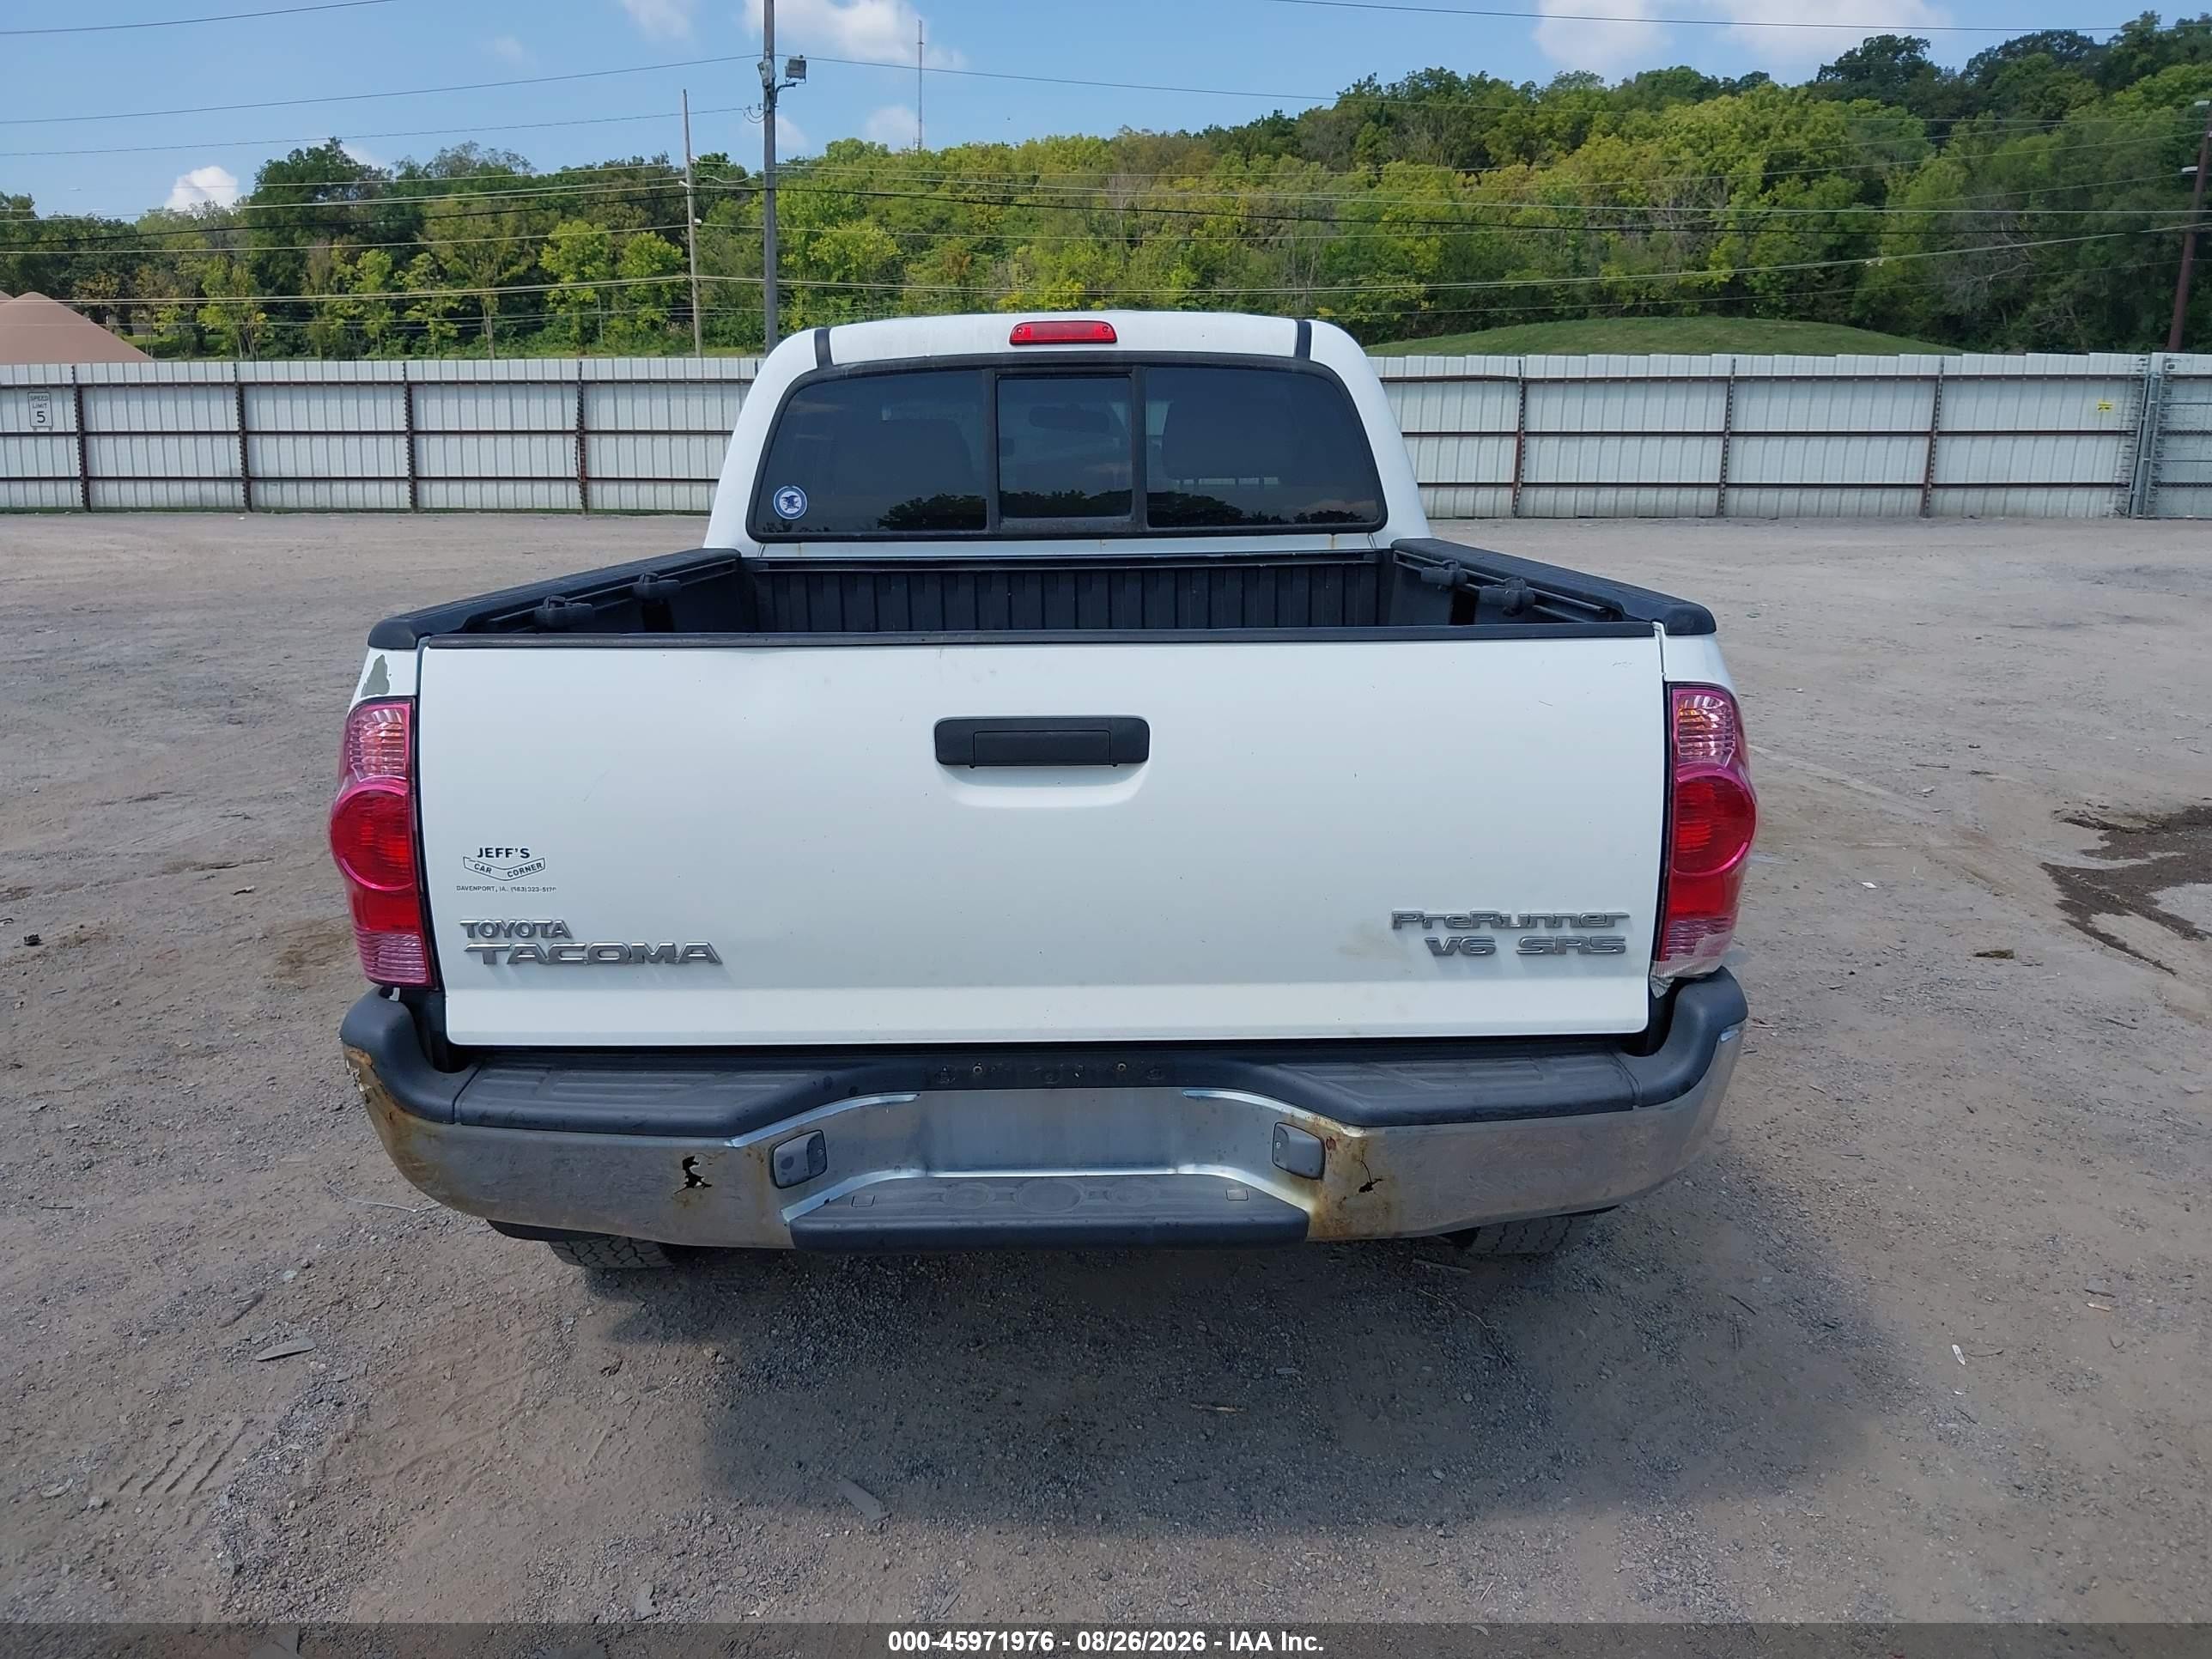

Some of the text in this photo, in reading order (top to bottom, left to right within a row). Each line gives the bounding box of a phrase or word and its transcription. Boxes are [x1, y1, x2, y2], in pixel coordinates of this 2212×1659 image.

[37, 410, 46, 423] 5
[477, 847, 531, 859] JEFF'S
[474, 862, 544, 878] CAR CORNER
[459, 919, 572, 939] TOYOTA
[1391, 910, 1630, 930] PreRunner
[464, 941, 723, 965] TACOMA
[1425, 935, 1626, 956] V6 SR5
